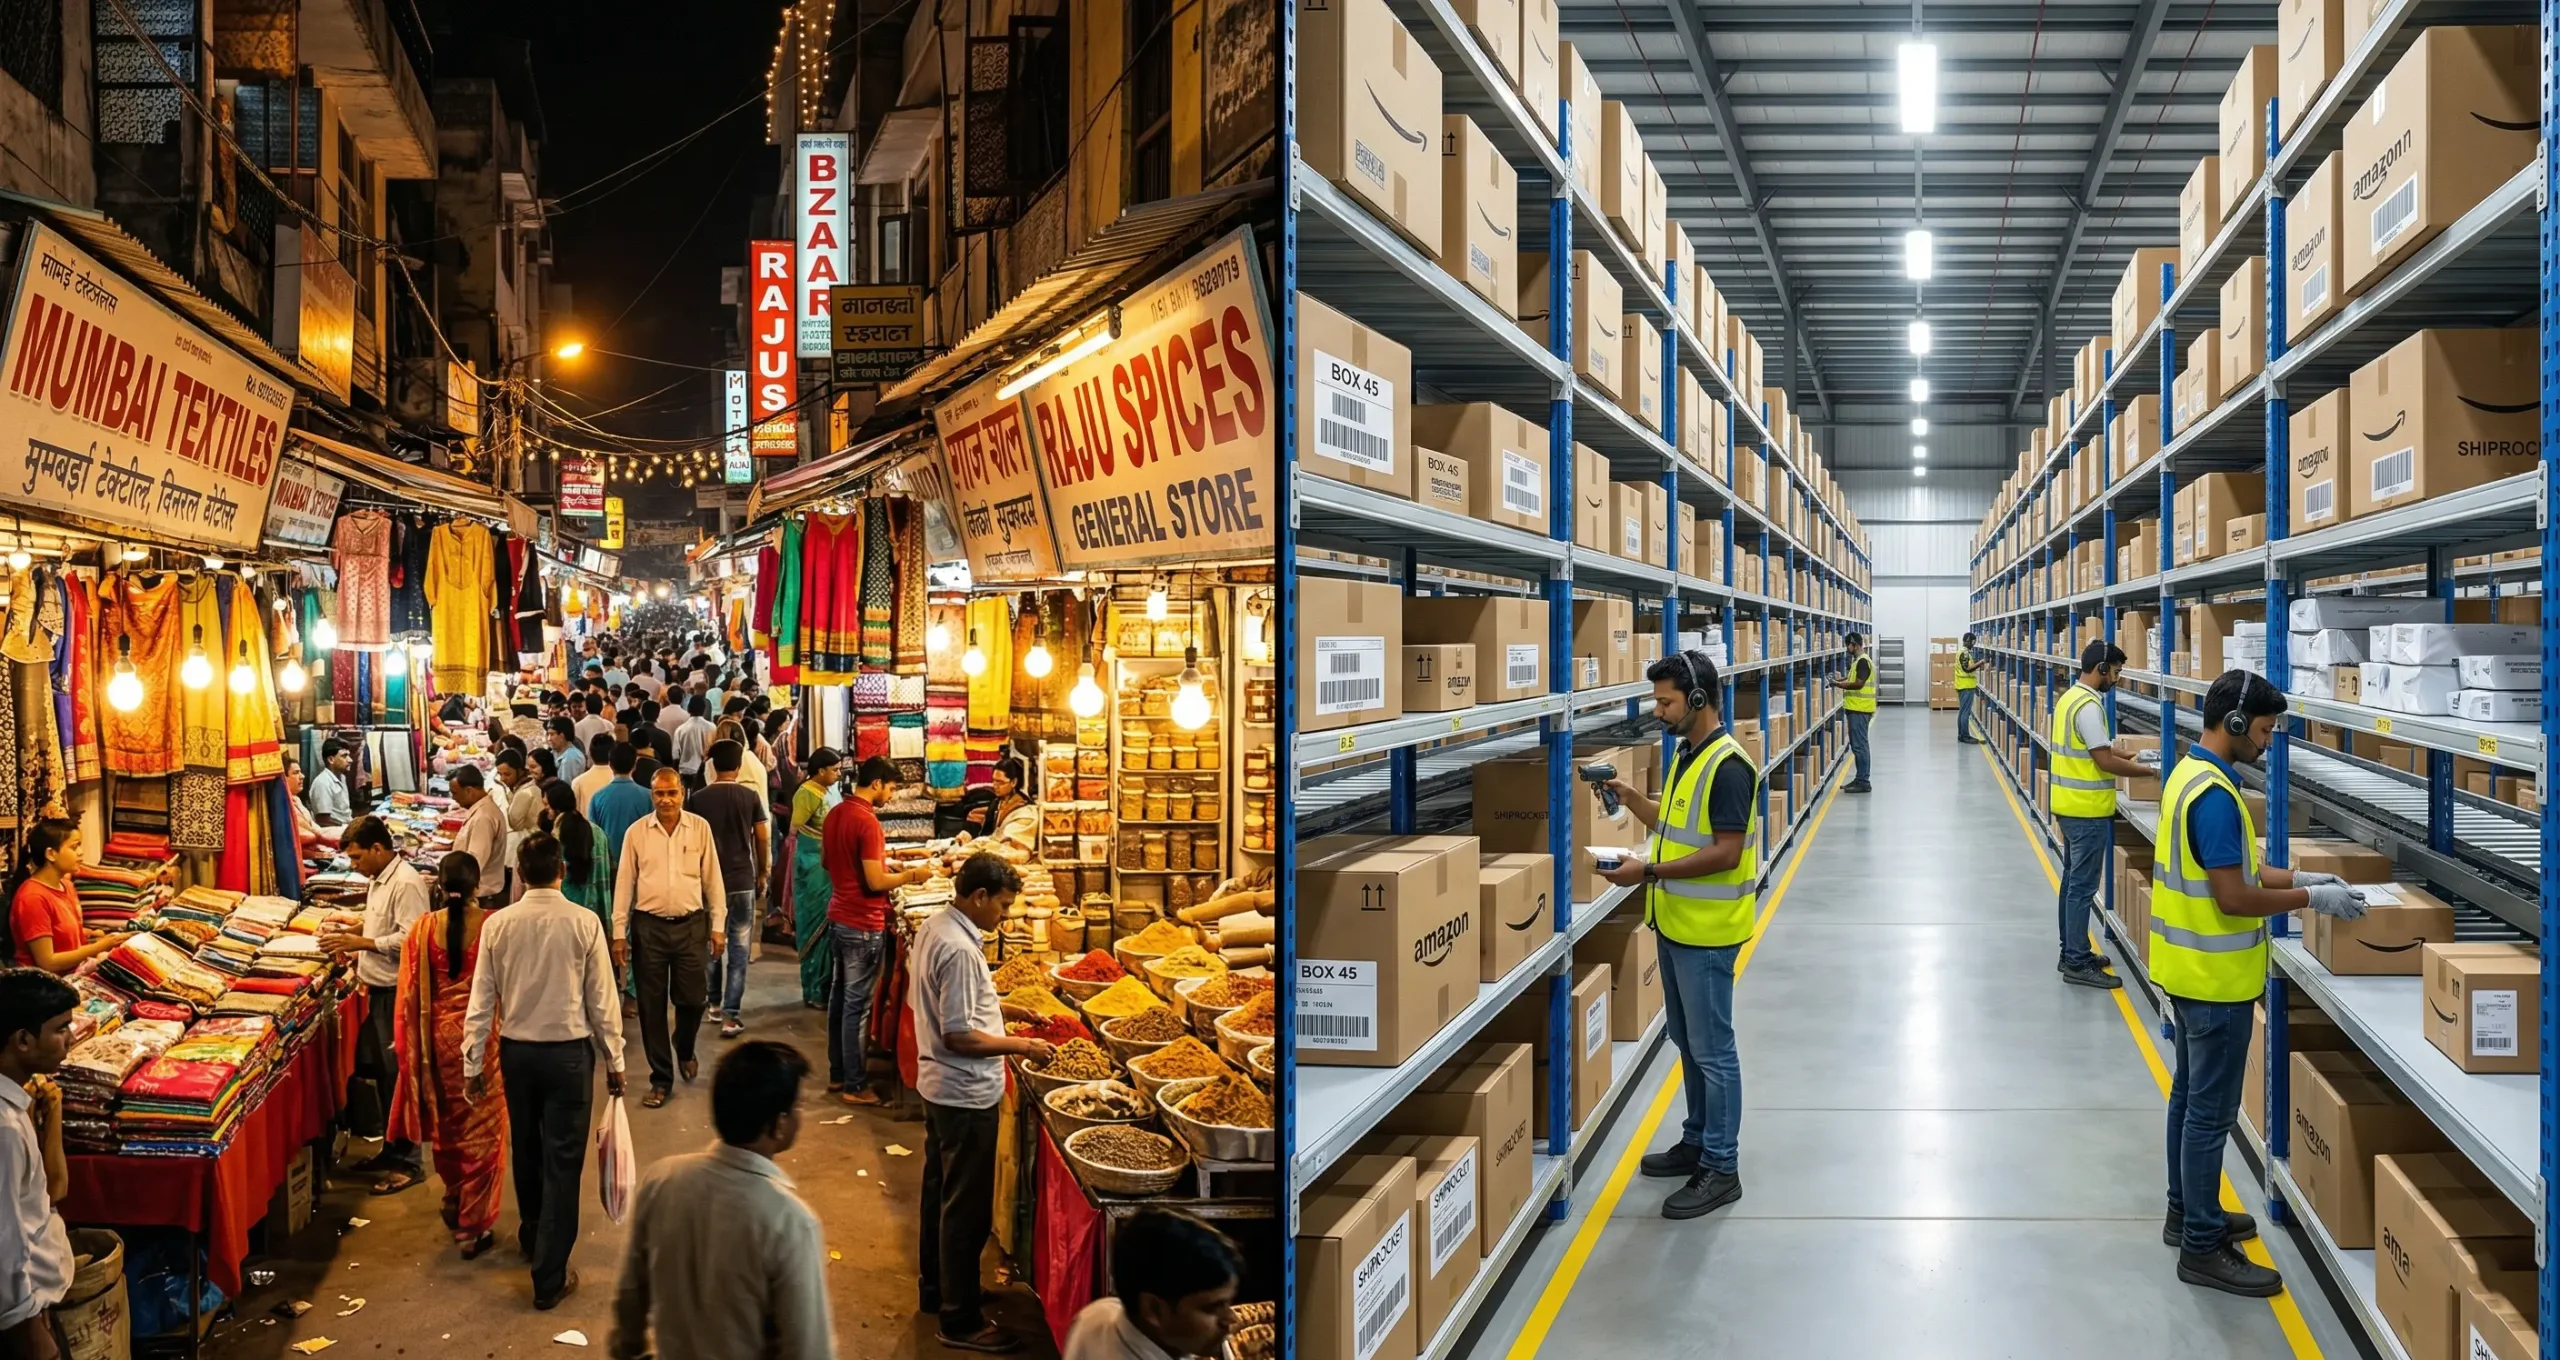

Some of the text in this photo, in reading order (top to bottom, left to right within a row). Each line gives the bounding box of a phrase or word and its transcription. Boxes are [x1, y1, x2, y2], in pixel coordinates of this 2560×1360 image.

[758, 253, 789, 411] RAJUS
[10, 293, 278, 488] MUMBAI TEXTILES
[1036, 305, 1265, 488] RAJU SPICES
[1332, 363, 1379, 397] BOX 45
[1428, 457, 1446, 472] BOX
[2458, 441, 2541, 456] SHIPROC
[1072, 468, 1264, 550] GENERAL STORE
[1414, 911, 1469, 963] amazon
[1301, 965, 1357, 979] BOX 45
[2296, 1108, 2331, 1165] amazon
[2383, 1226, 2411, 1276] ama
